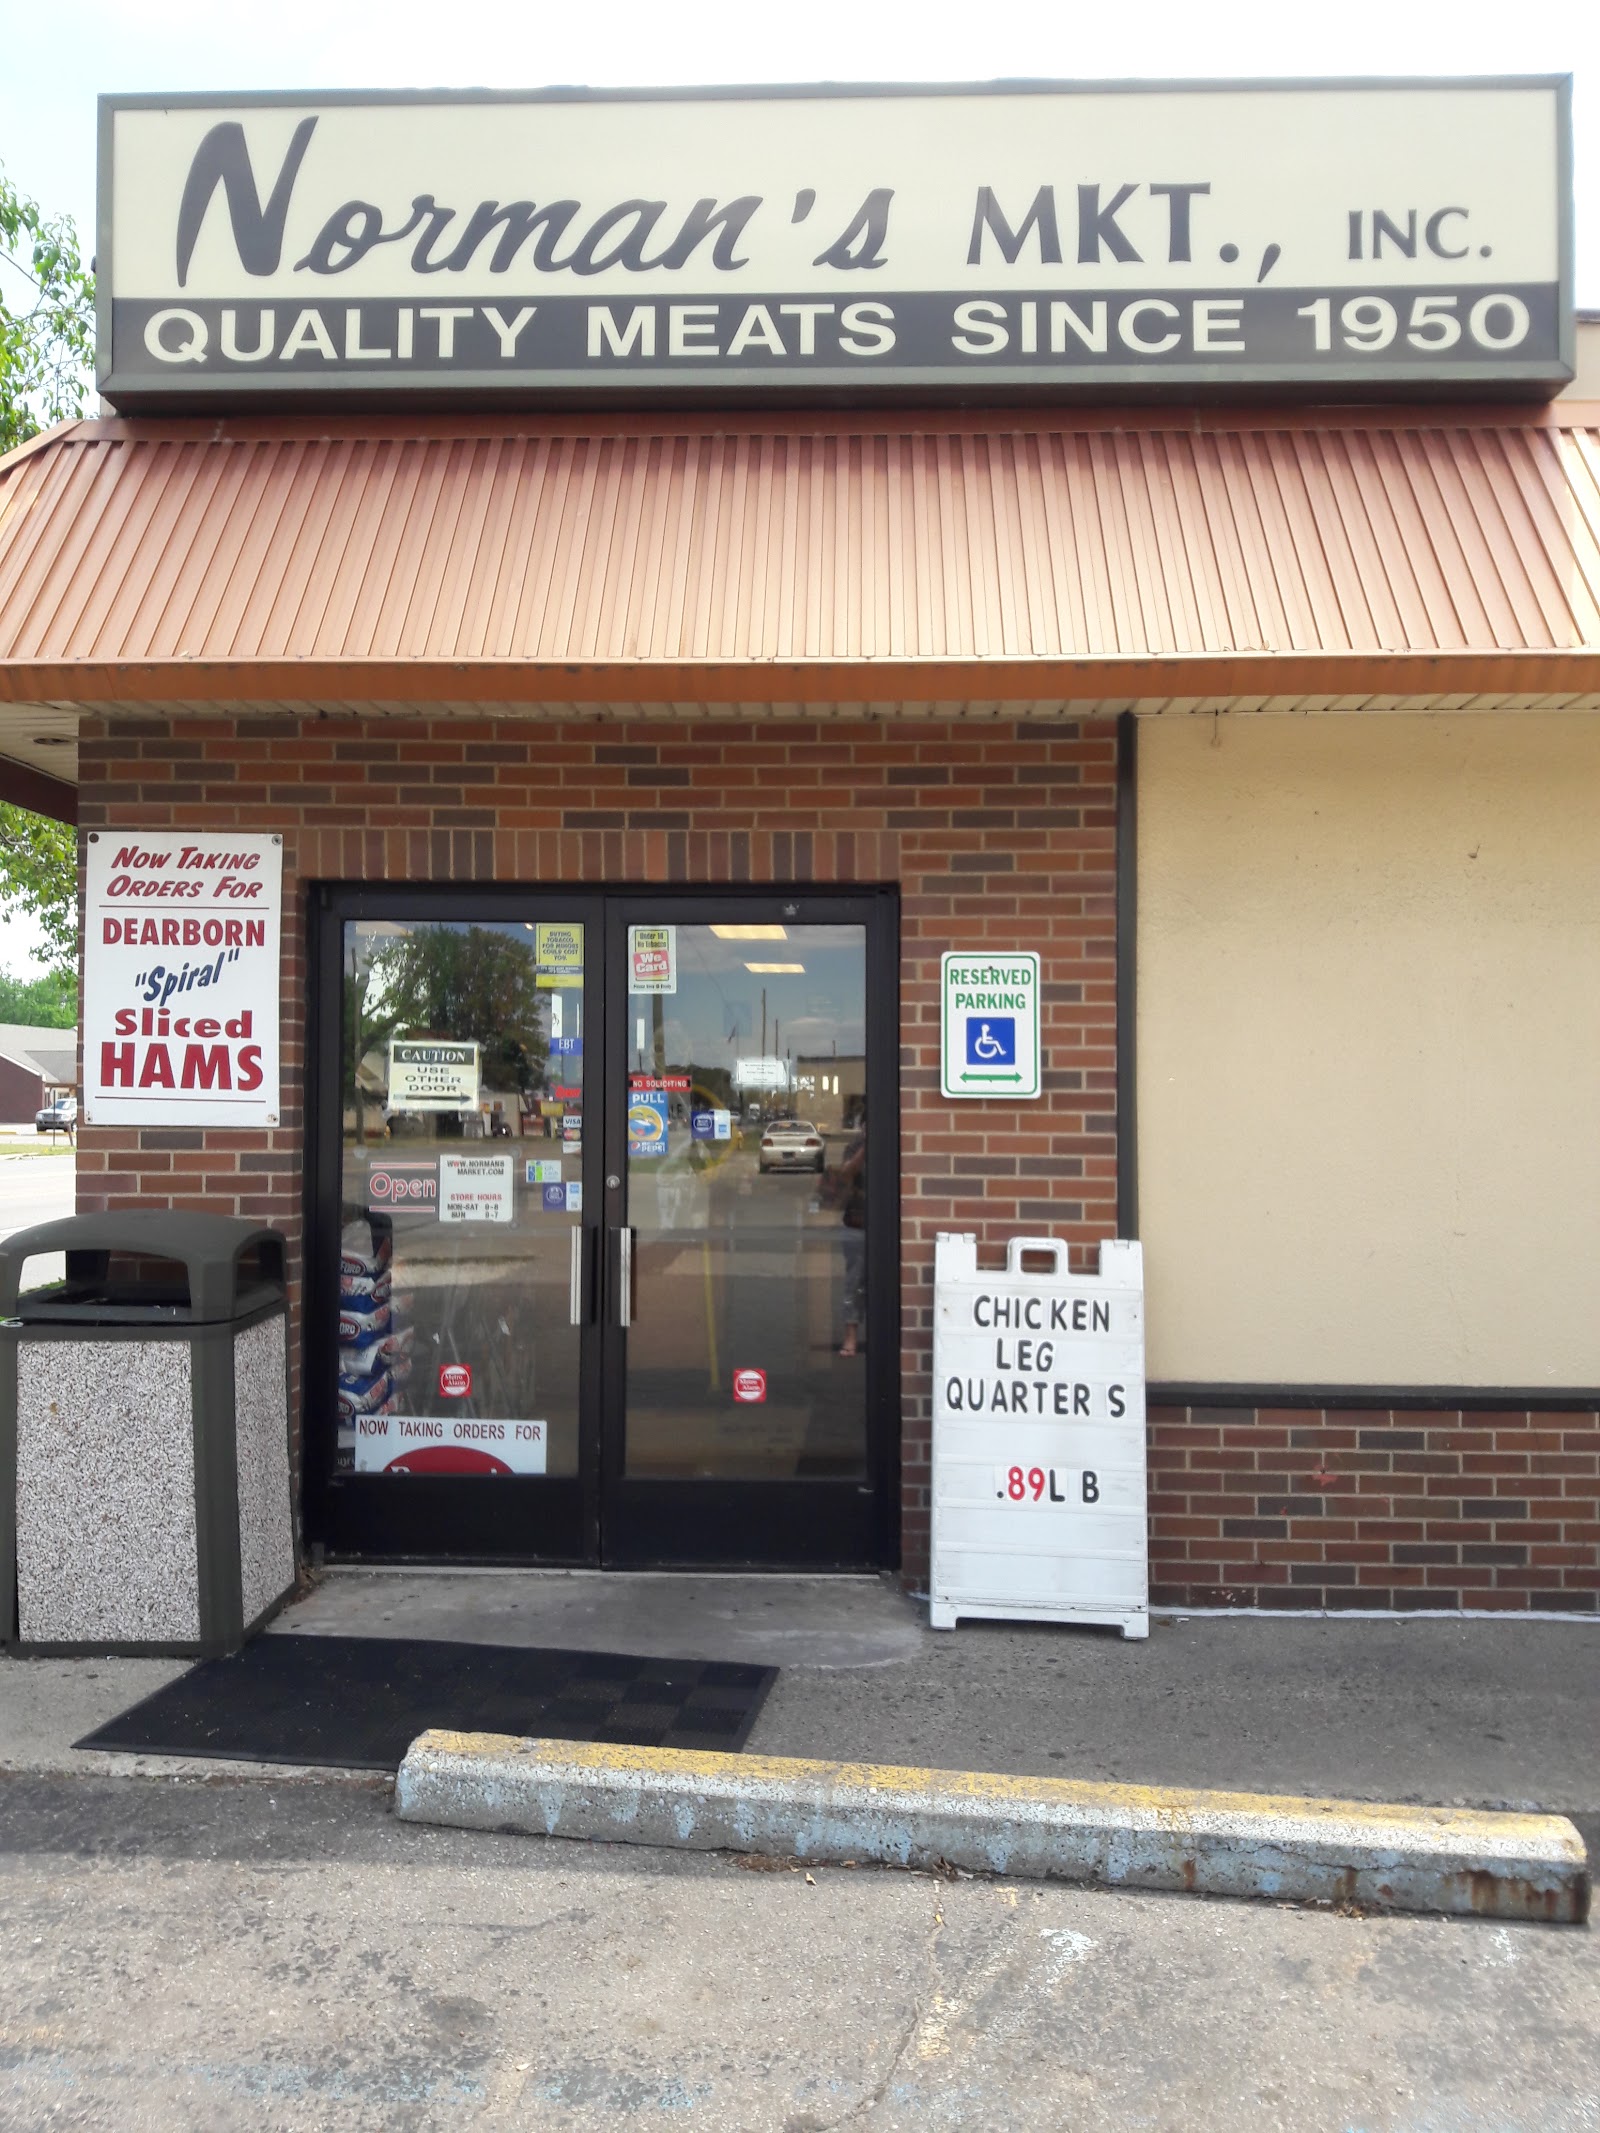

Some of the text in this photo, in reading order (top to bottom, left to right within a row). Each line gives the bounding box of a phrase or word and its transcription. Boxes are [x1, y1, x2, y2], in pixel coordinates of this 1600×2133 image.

[176, 115, 895, 288] Norman's
[1348, 207, 1493, 261] INC.
[143, 293, 1530, 364] QUALITY MEATS SINCE 1950
[103, 918, 264, 946] DEARBORN
[636, 961, 667, 973] Card
[640, 953, 662, 963] We
[135, 948, 240, 1007] "Spiral"
[950, 968, 1031, 985] RESERVED
[955, 993, 1026, 1009] PARKING
[115, 1007, 252, 1038] Sliced
[559, 1038, 574, 1049] EBT
[100, 1041, 264, 1091] HAMS
[401, 1049, 465, 1062] CAUTION
[405, 1075, 461, 1083] OTHER
[418, 1066, 449, 1074] USE
[632, 1093, 664, 1104] PULL
[369, 1172, 436, 1202] Open
[974, 1295, 1110, 1333] CHICKEN
[996, 1337, 1054, 1372] LEG
[359, 1419, 541, 1440] NOW TAKING ORDERS FOR
